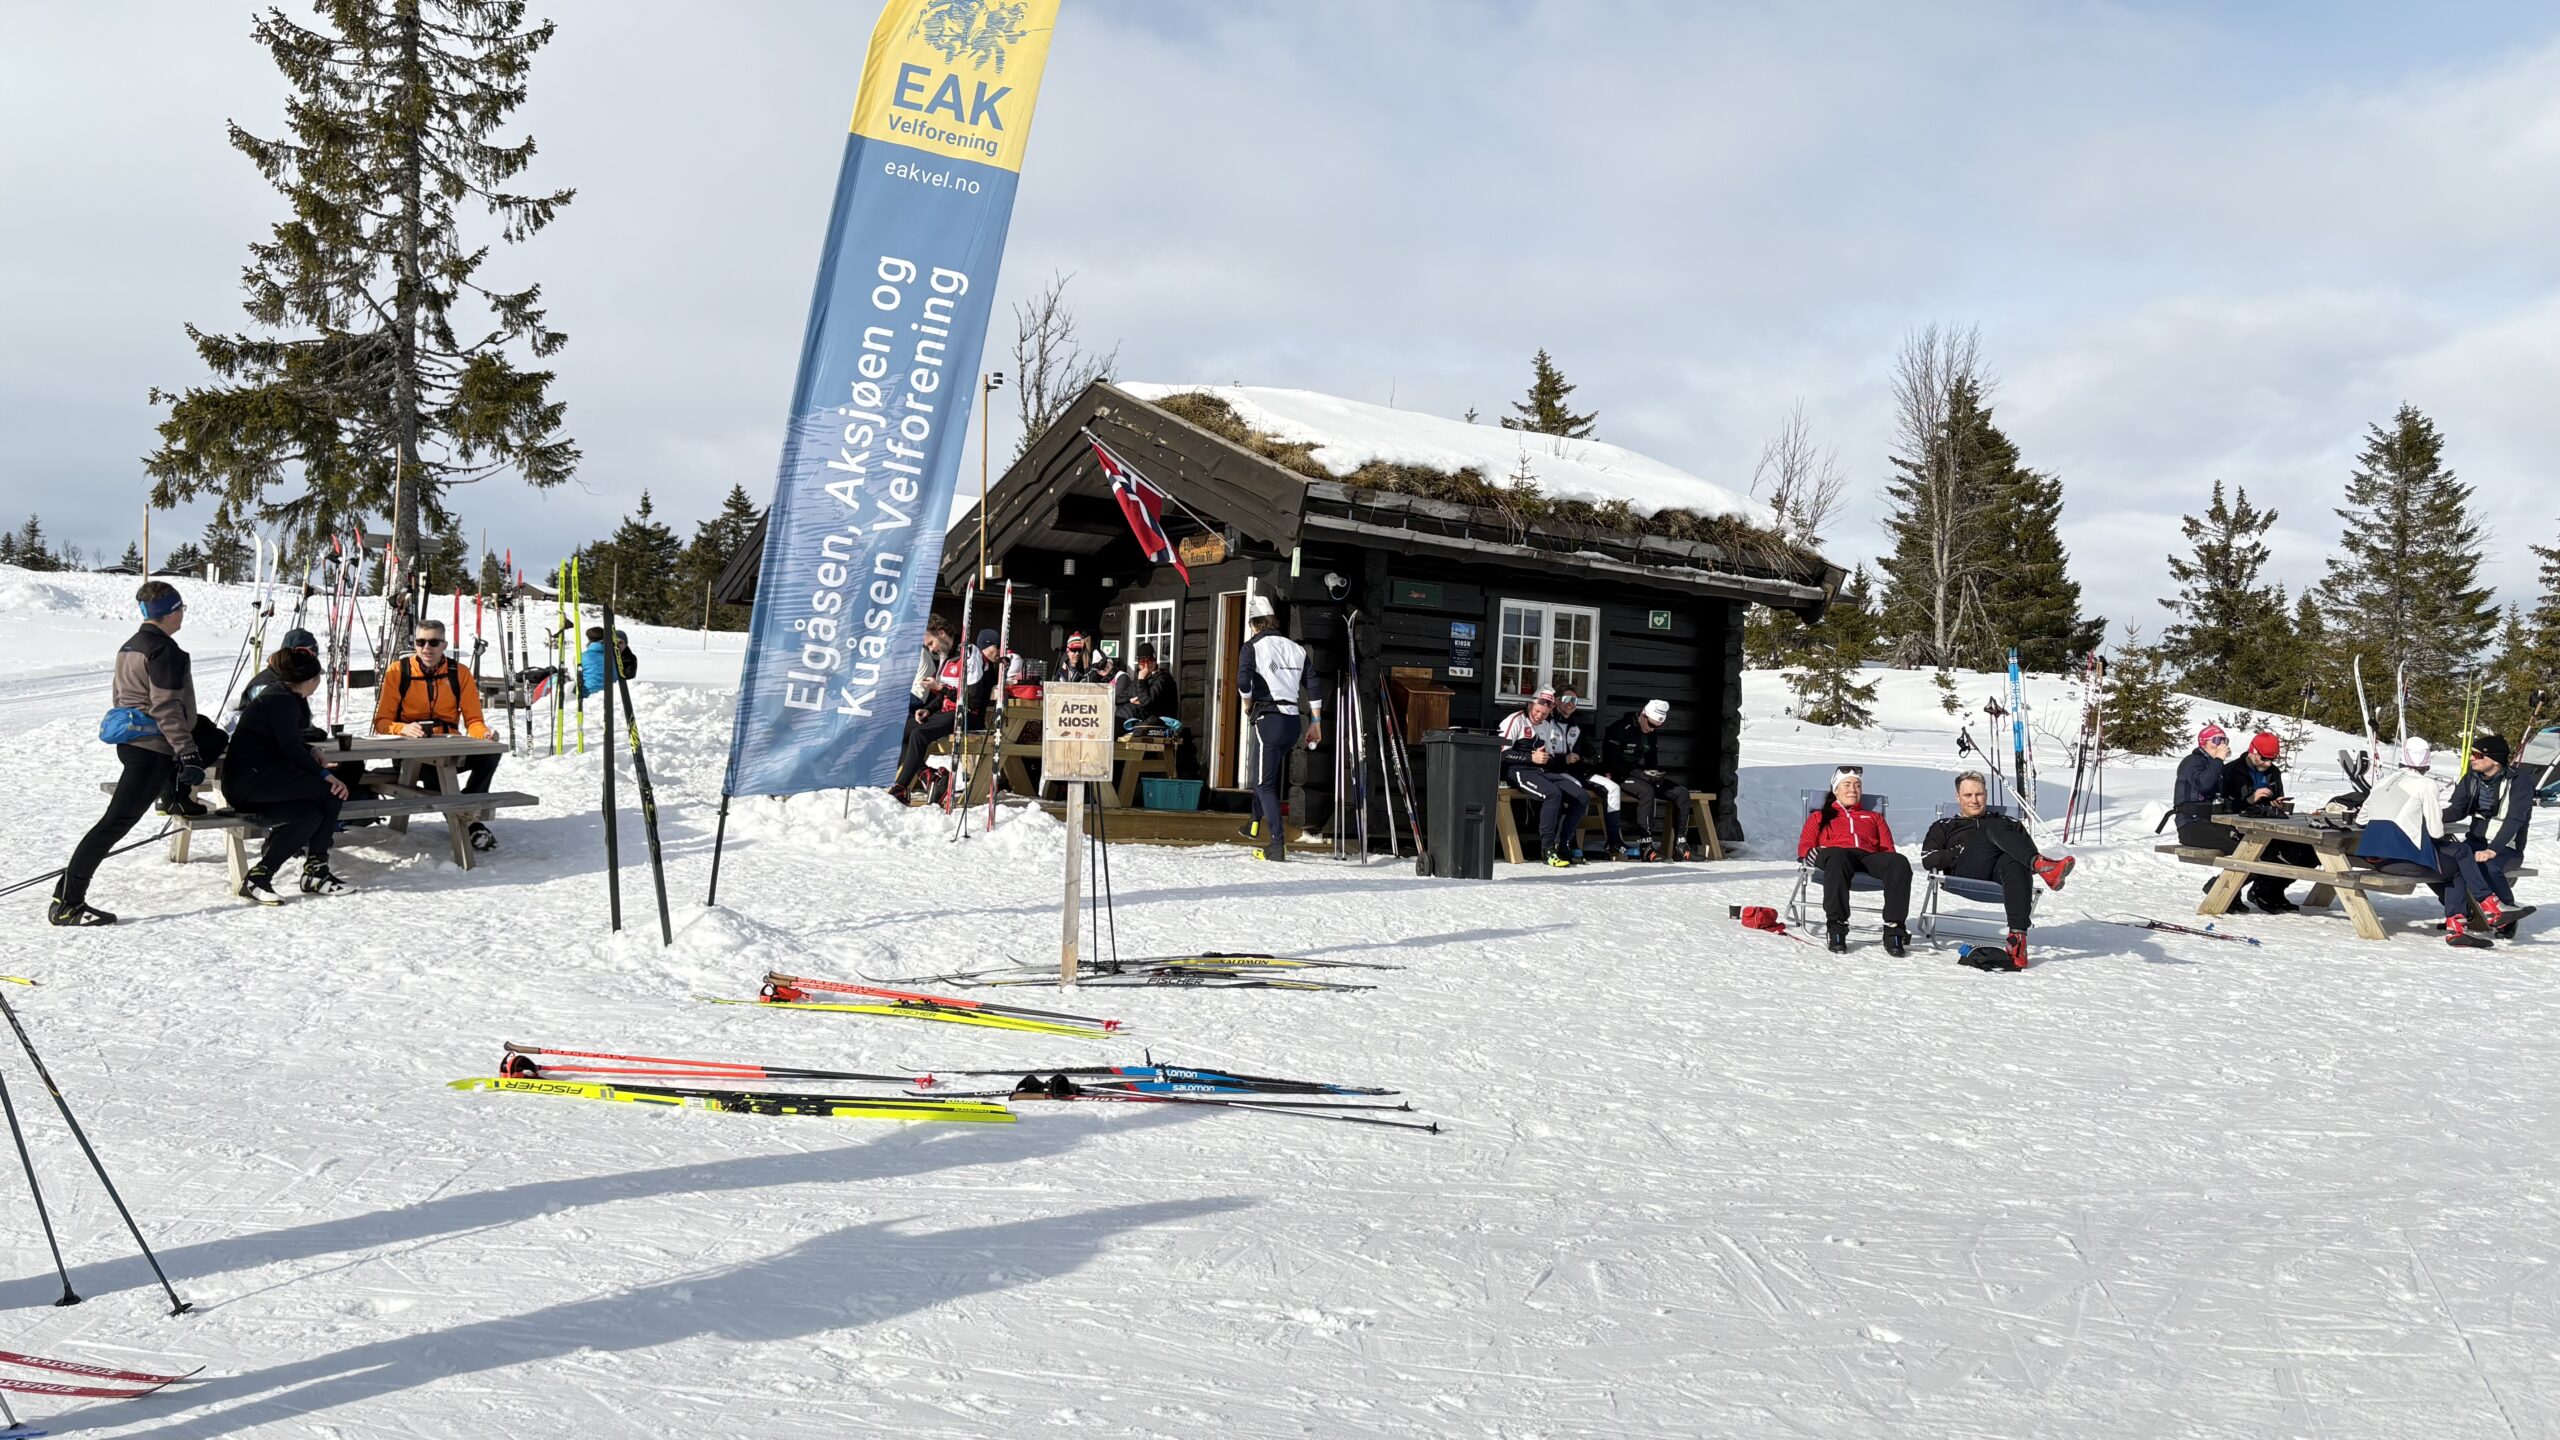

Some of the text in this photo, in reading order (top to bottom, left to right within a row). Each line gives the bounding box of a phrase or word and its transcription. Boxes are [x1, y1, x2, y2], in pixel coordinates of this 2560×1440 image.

[893, 62, 1013, 131] EAK
[888, 113, 998, 157] Velforening
[884, 161, 980, 194] eakvel.no
[784, 255, 917, 711] Elgåsen, Aksjøen og
[837, 266, 969, 717] Kuåsen Velforening
[1061, 701, 1098, 714] ÅPEN
[1058, 717, 1100, 727] KIOSK
[1146, 977, 1205, 985] FISCHER
[892, 1009, 938, 1018] FISCHER
[505, 1080, 584, 1095] FISCHER
[1172, 1084, 1215, 1092] salomon
